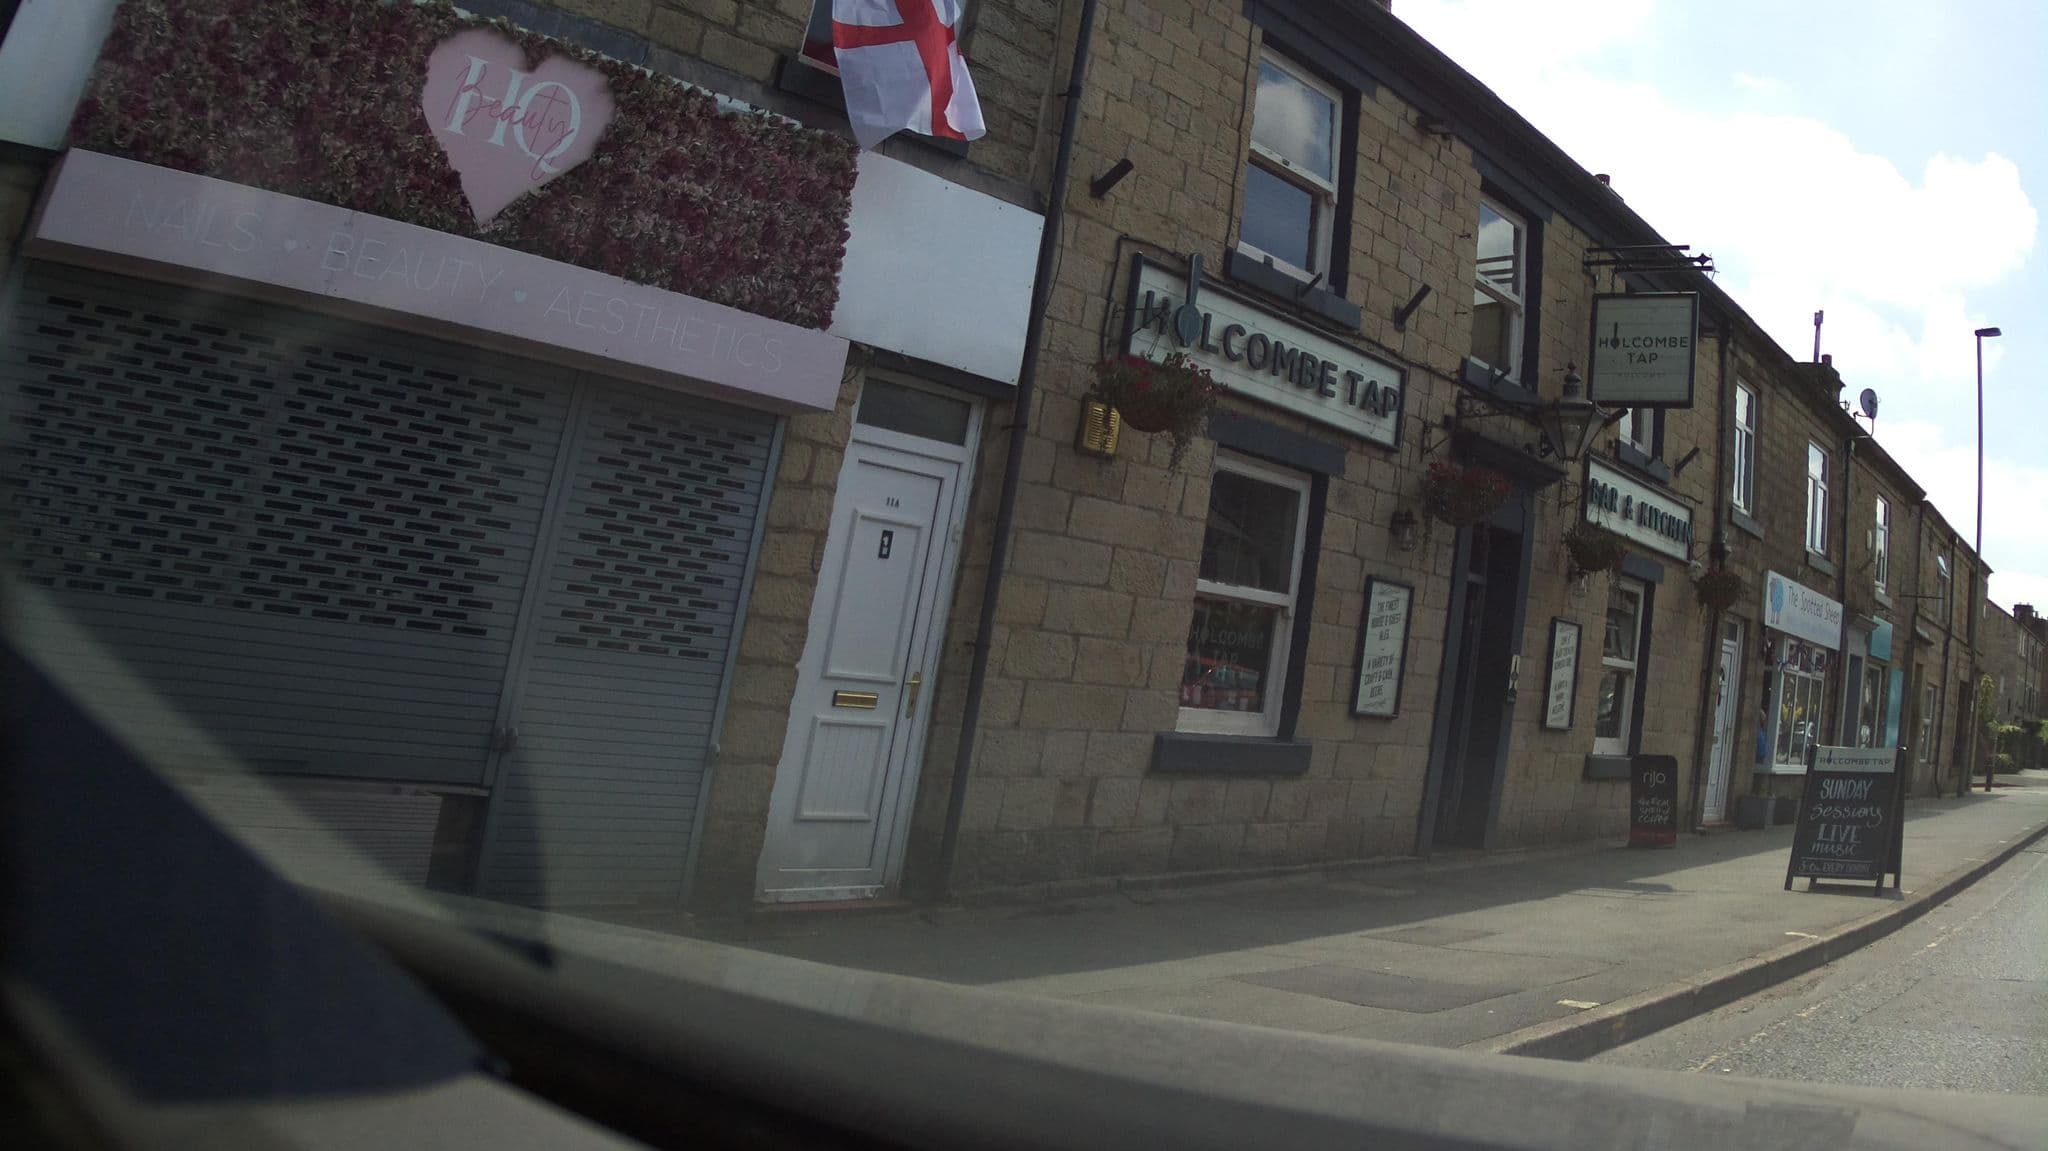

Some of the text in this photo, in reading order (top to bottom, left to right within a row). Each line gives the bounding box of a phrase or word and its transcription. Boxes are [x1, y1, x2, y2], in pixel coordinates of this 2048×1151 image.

[442, 54, 581, 174] HQ
[445, 63, 574, 181] Beauty
[124, 189, 786, 375] NAILS BEAUTY AESTHETICS
[1141, 254, 1400, 418] HOLCOMBE TAP
[1599, 326, 1689, 350] HOLCOMBE
[1627, 352, 1659, 364] TAP
[1591, 478, 1693, 545] BAR & KITCHEN
[1788, 585, 1799, 608] The
[1820, 752, 1891, 766] HOLCOMBE TAP
[1820, 778, 1873, 801] SUNDAY
[1817, 823, 1861, 844] LIVE
